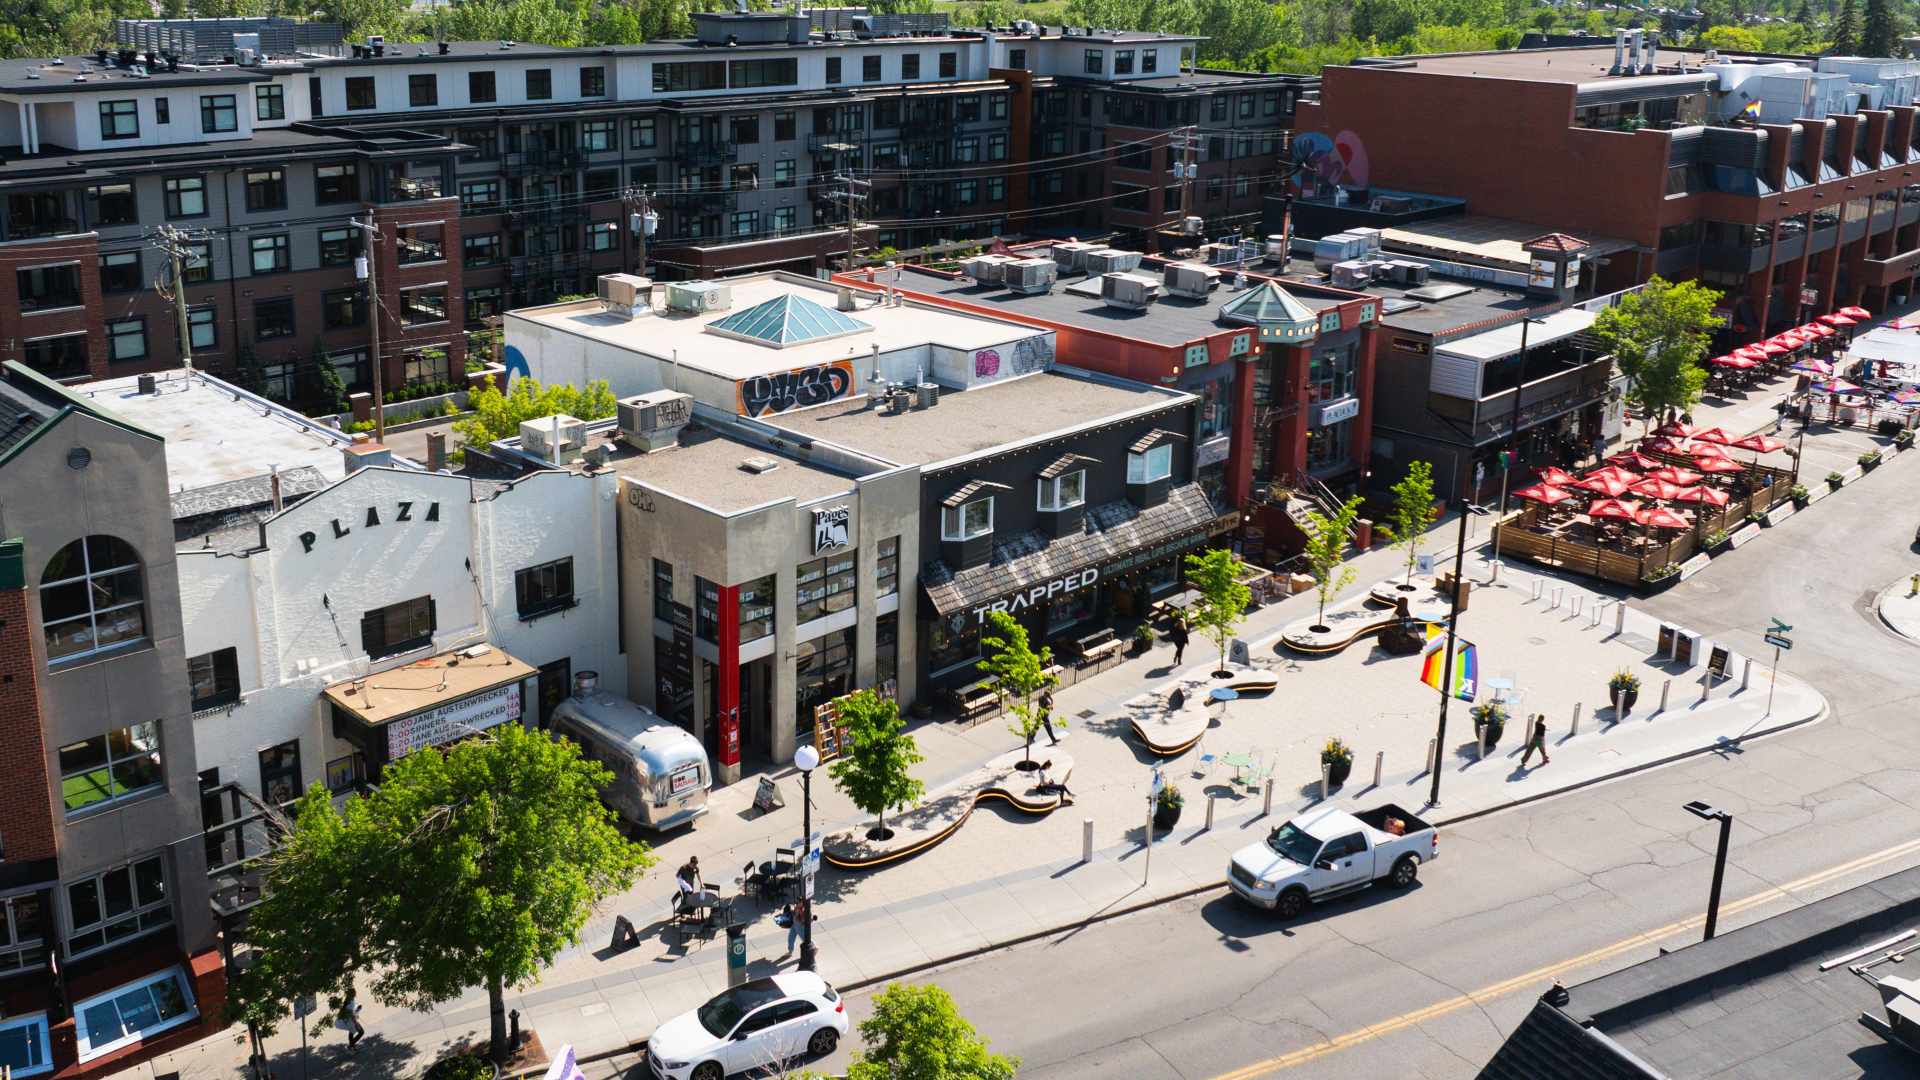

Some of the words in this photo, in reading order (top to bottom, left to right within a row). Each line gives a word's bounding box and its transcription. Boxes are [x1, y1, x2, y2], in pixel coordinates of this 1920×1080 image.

[815, 507, 849, 526] Pages
[298, 501, 440, 554] PLAZA
[973, 569, 1099, 624] TRAPPED
[410, 718, 446, 735] SINNERS
[414, 710, 435, 725] JANE
